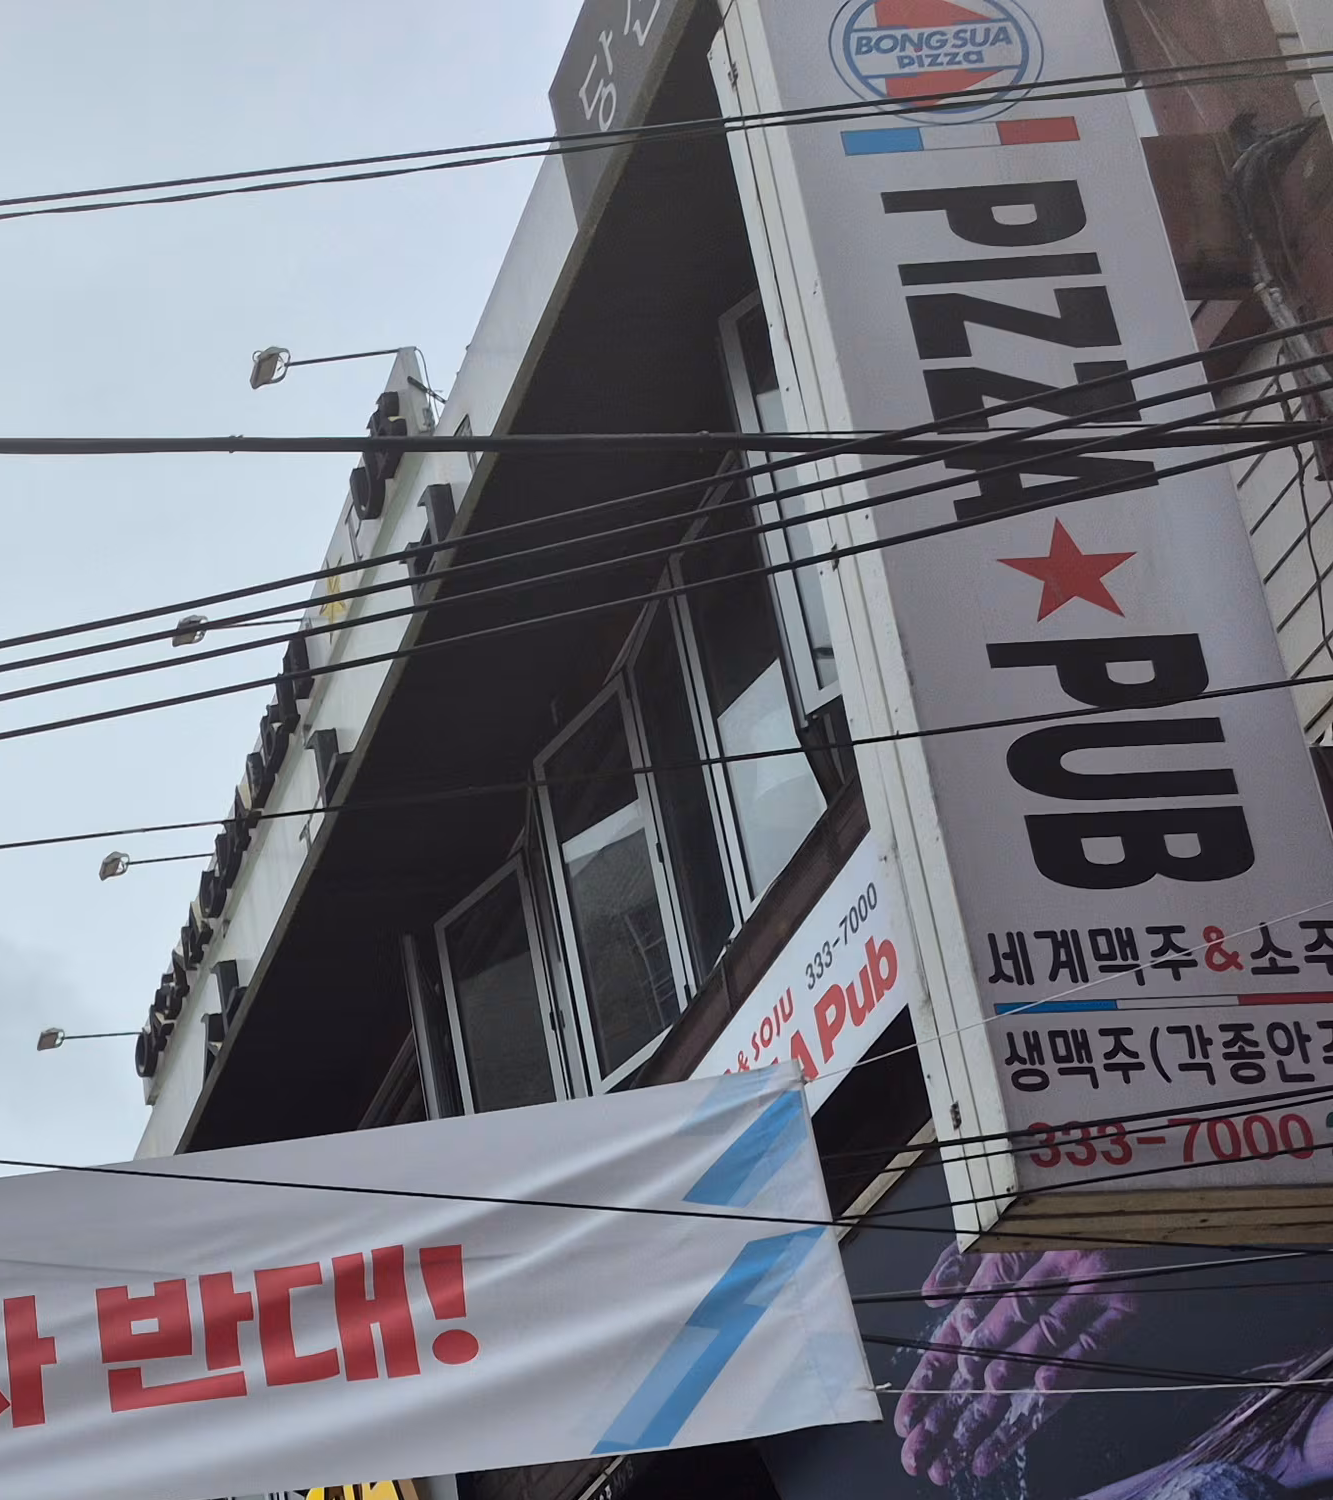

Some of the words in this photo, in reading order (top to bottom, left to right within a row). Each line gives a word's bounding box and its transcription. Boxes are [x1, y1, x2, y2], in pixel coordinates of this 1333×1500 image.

[985, 632, 1256, 890] PUB
[804, 882, 879, 991] 333-7000
[750, 988, 794, 1059] SOJU
[1026, 1113, 1315, 1171] 333-7000
[93, 1242, 480, 1413] 반대!
